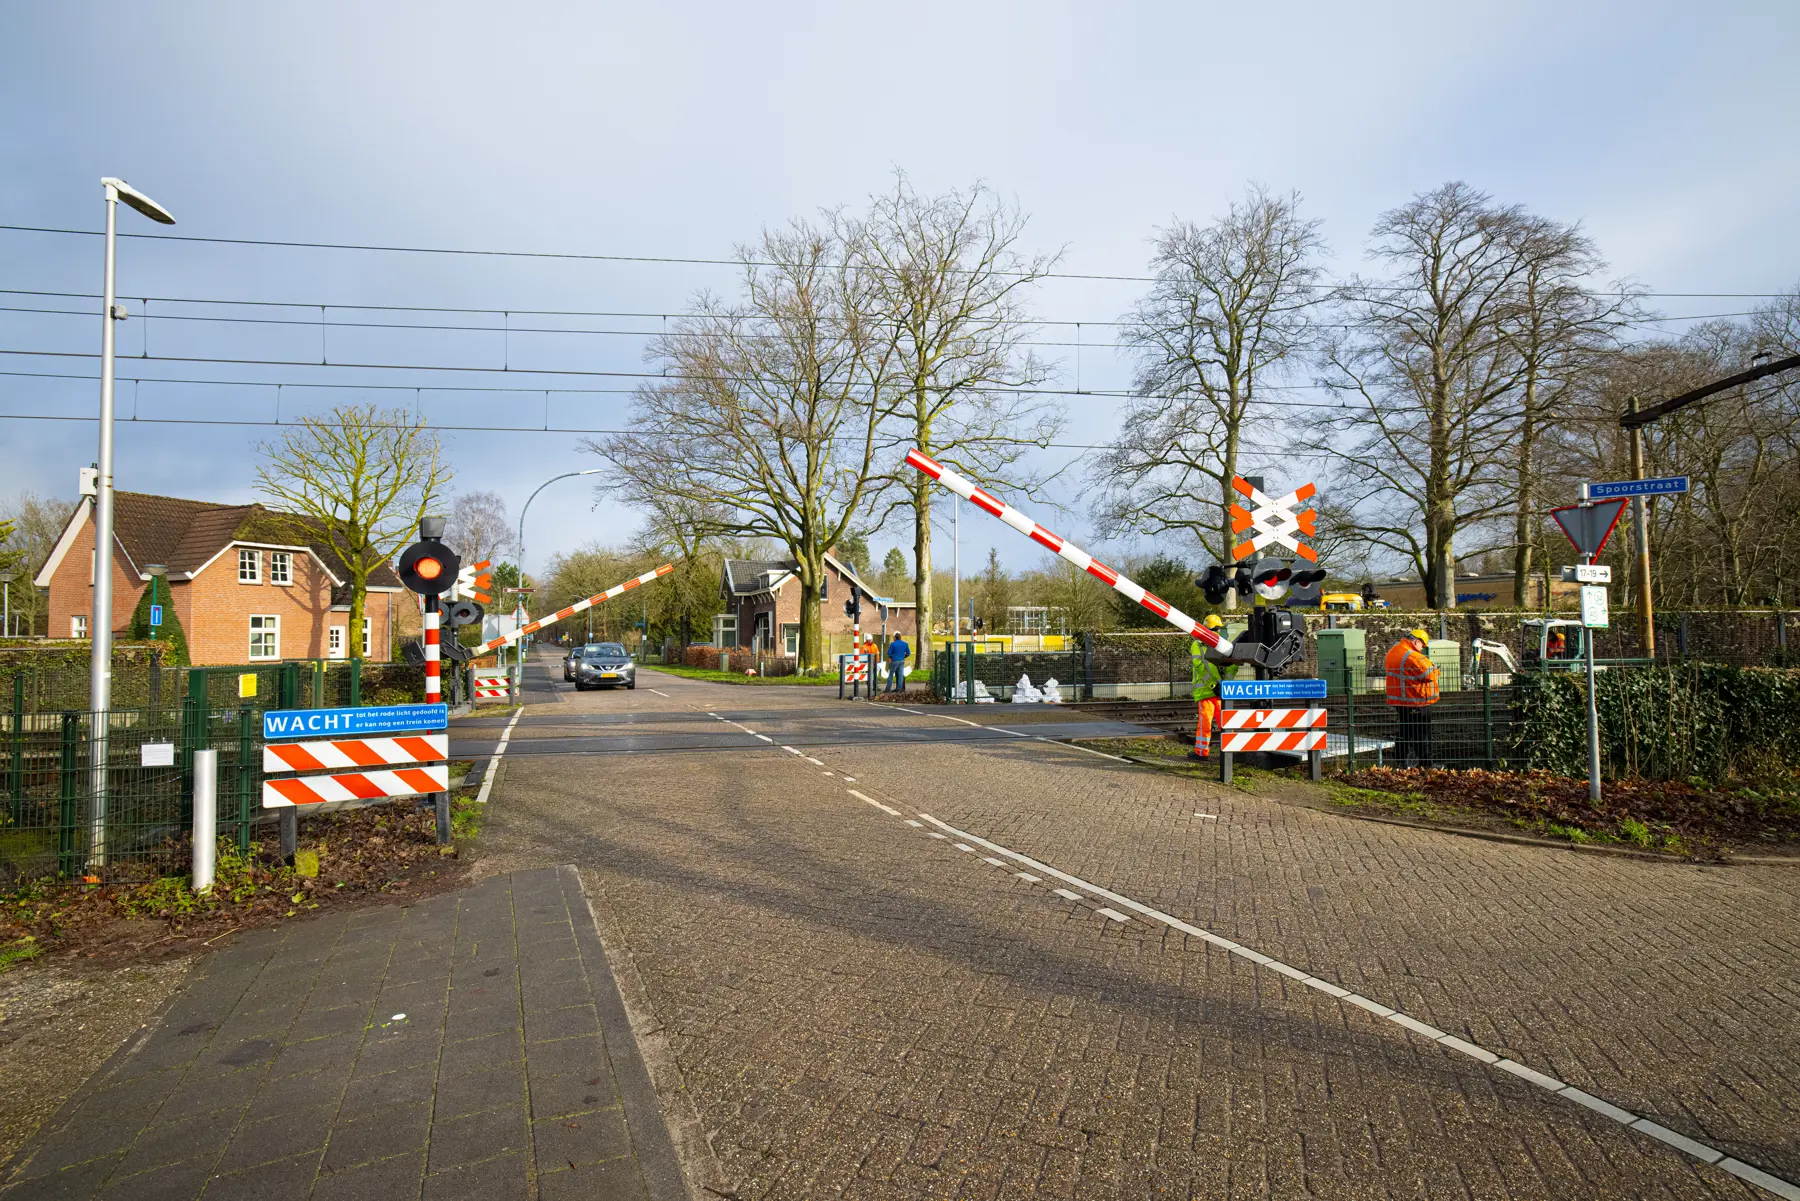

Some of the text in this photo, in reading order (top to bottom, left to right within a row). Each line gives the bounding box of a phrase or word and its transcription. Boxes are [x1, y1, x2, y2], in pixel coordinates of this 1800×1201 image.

[1580, 568, 1597, 578] 17-19
[1223, 684, 1272, 696] WACHT
[412, 708, 438, 716] gedoofd
[266, 713, 354, 733] WACHT
